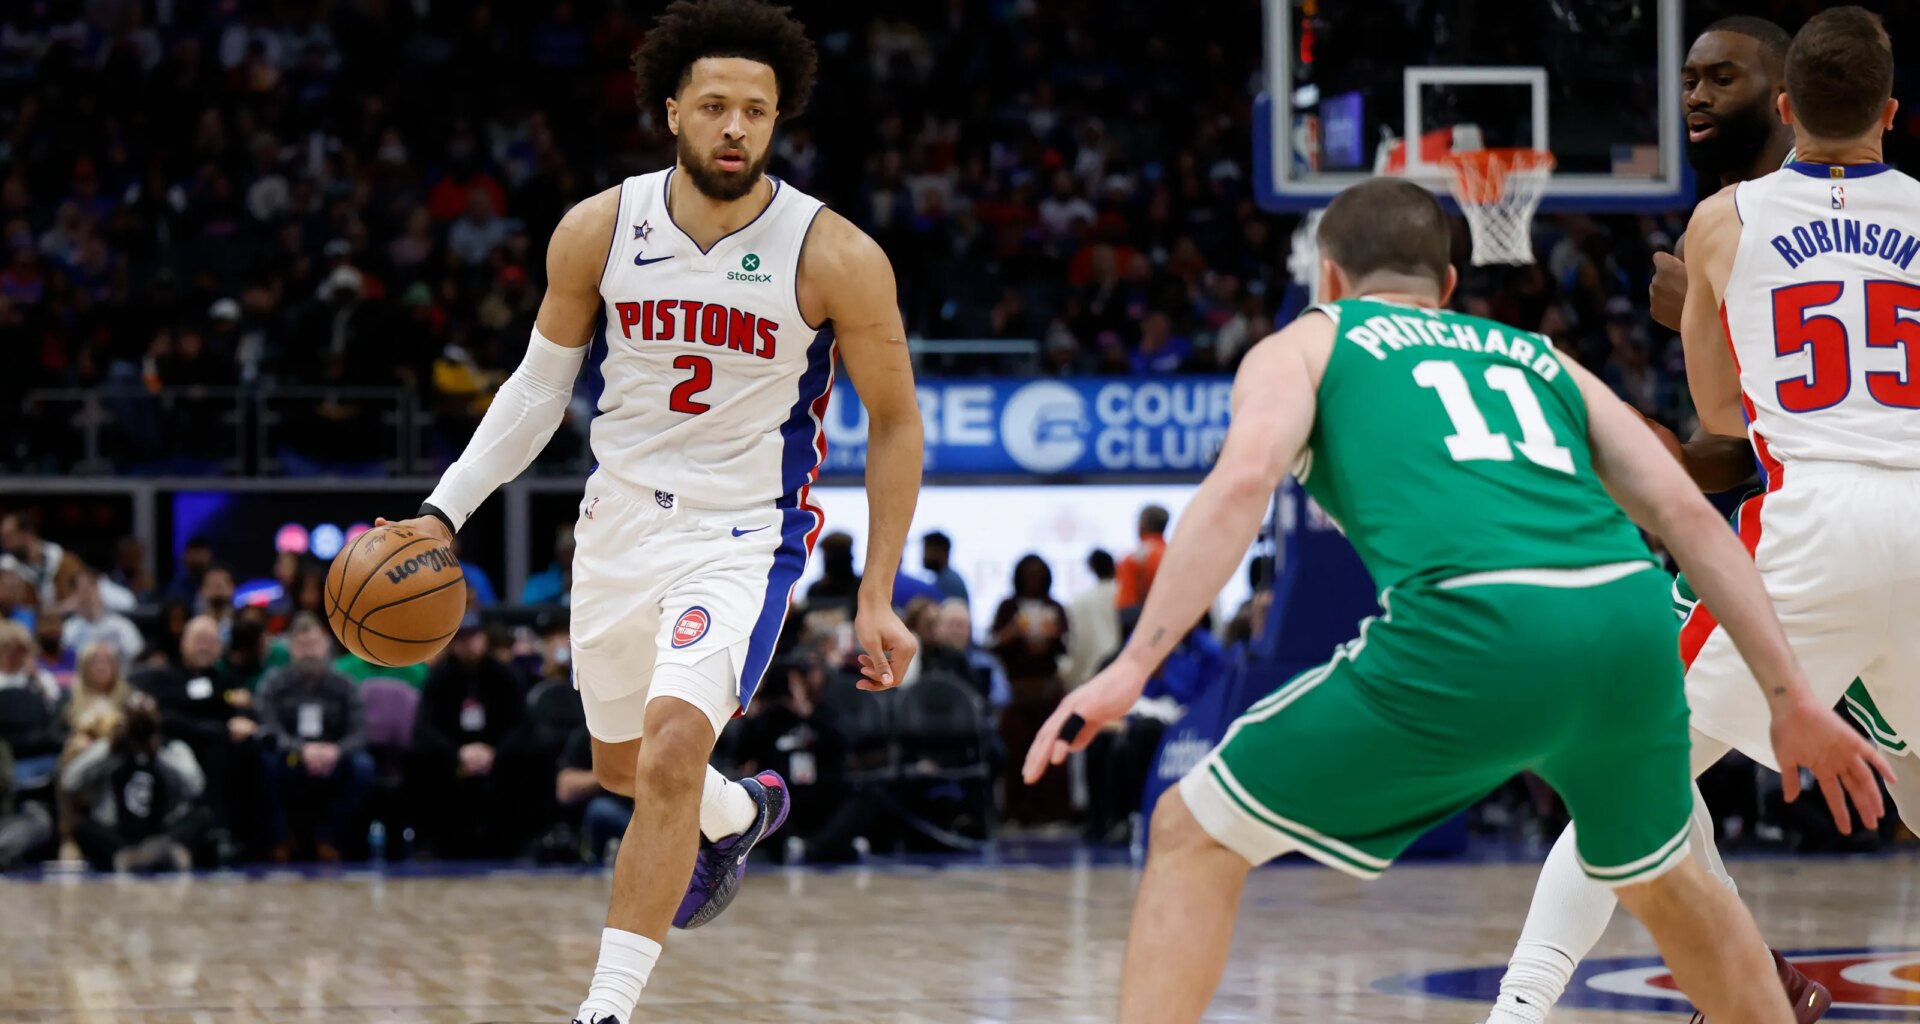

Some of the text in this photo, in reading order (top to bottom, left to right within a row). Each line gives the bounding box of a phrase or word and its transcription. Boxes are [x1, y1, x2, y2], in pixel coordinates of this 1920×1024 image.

[1770, 218, 1920, 270] ROBINSON
[726, 271, 772, 283] StockX
[615, 299, 779, 359] PISTONS
[1345, 313, 1561, 382] PRITCHARD
[1771, 279, 1920, 413] 55
[669, 354, 713, 415] 2
[1412, 360, 1576, 475] 11
